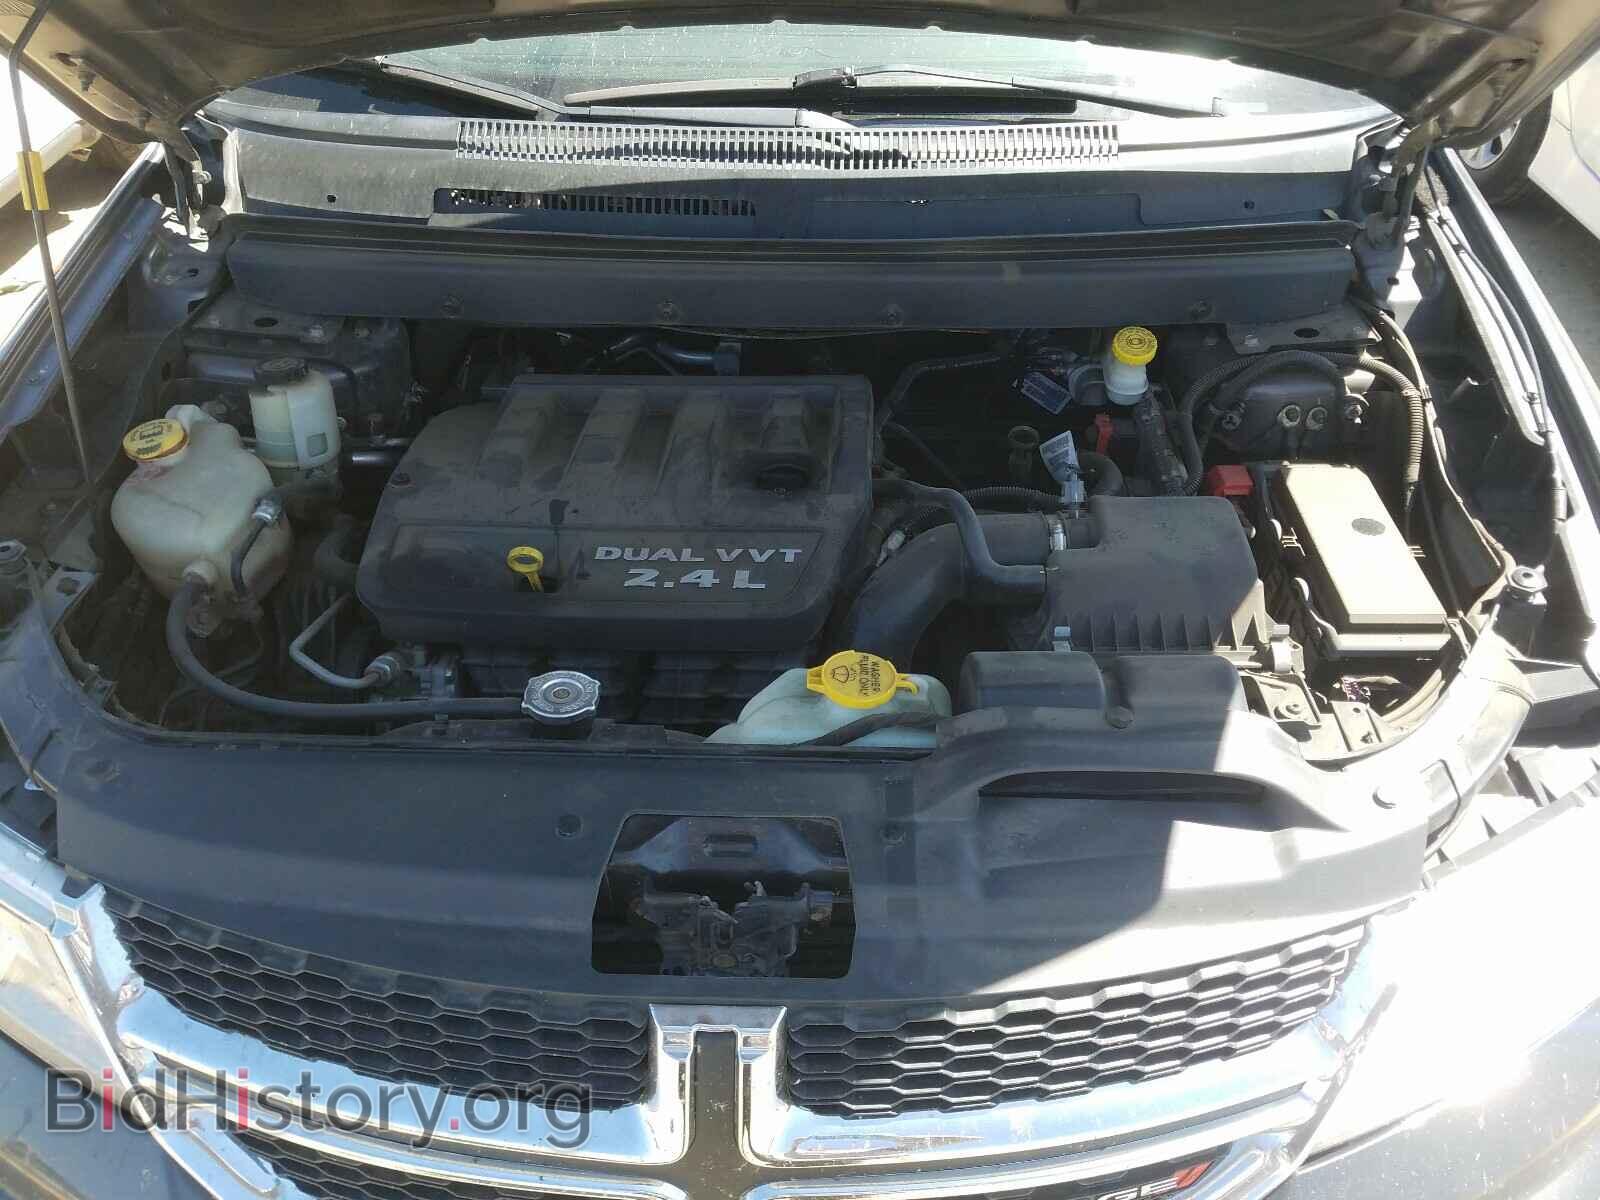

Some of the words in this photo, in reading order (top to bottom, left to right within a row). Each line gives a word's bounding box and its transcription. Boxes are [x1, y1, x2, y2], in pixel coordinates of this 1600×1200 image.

[594, 546, 705, 562] DUAL
[716, 548, 802, 563] VVT
[871, 661, 881, 693] WASHER
